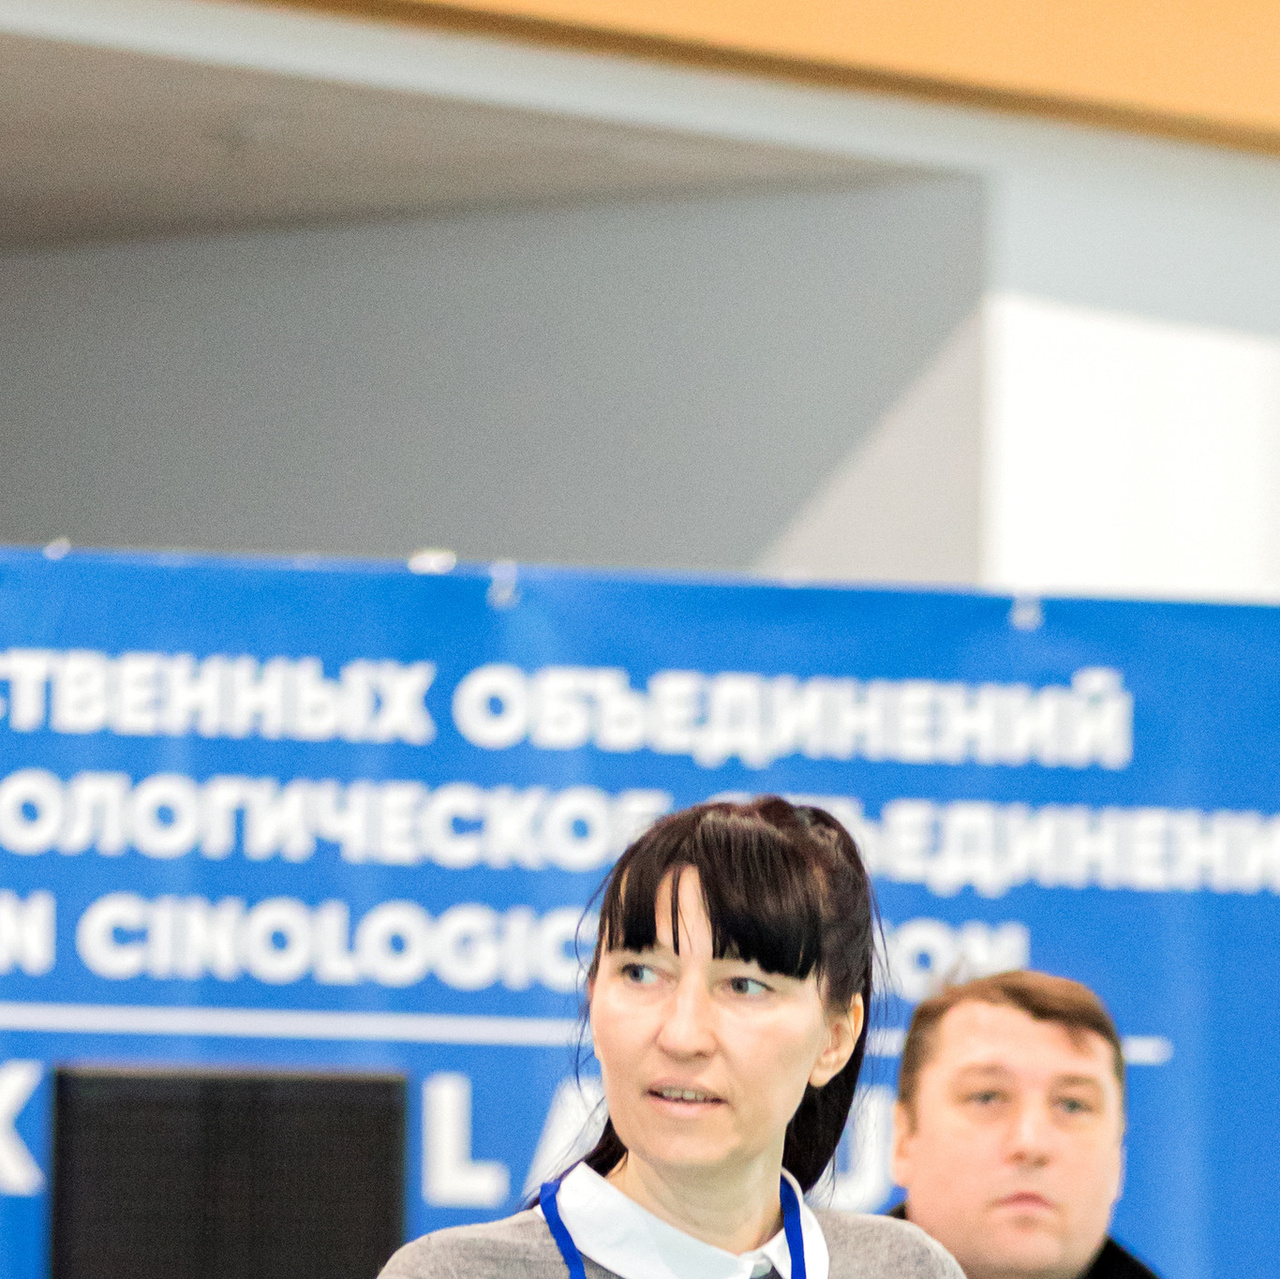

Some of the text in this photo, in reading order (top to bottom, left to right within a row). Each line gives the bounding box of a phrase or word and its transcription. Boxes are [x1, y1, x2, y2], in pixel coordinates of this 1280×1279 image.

[0, 648, 1134, 770] ТВЕННЫХ ОБЪЕДИНЕНИЙ
[76, 891, 598, 993] CINOLOGIC
